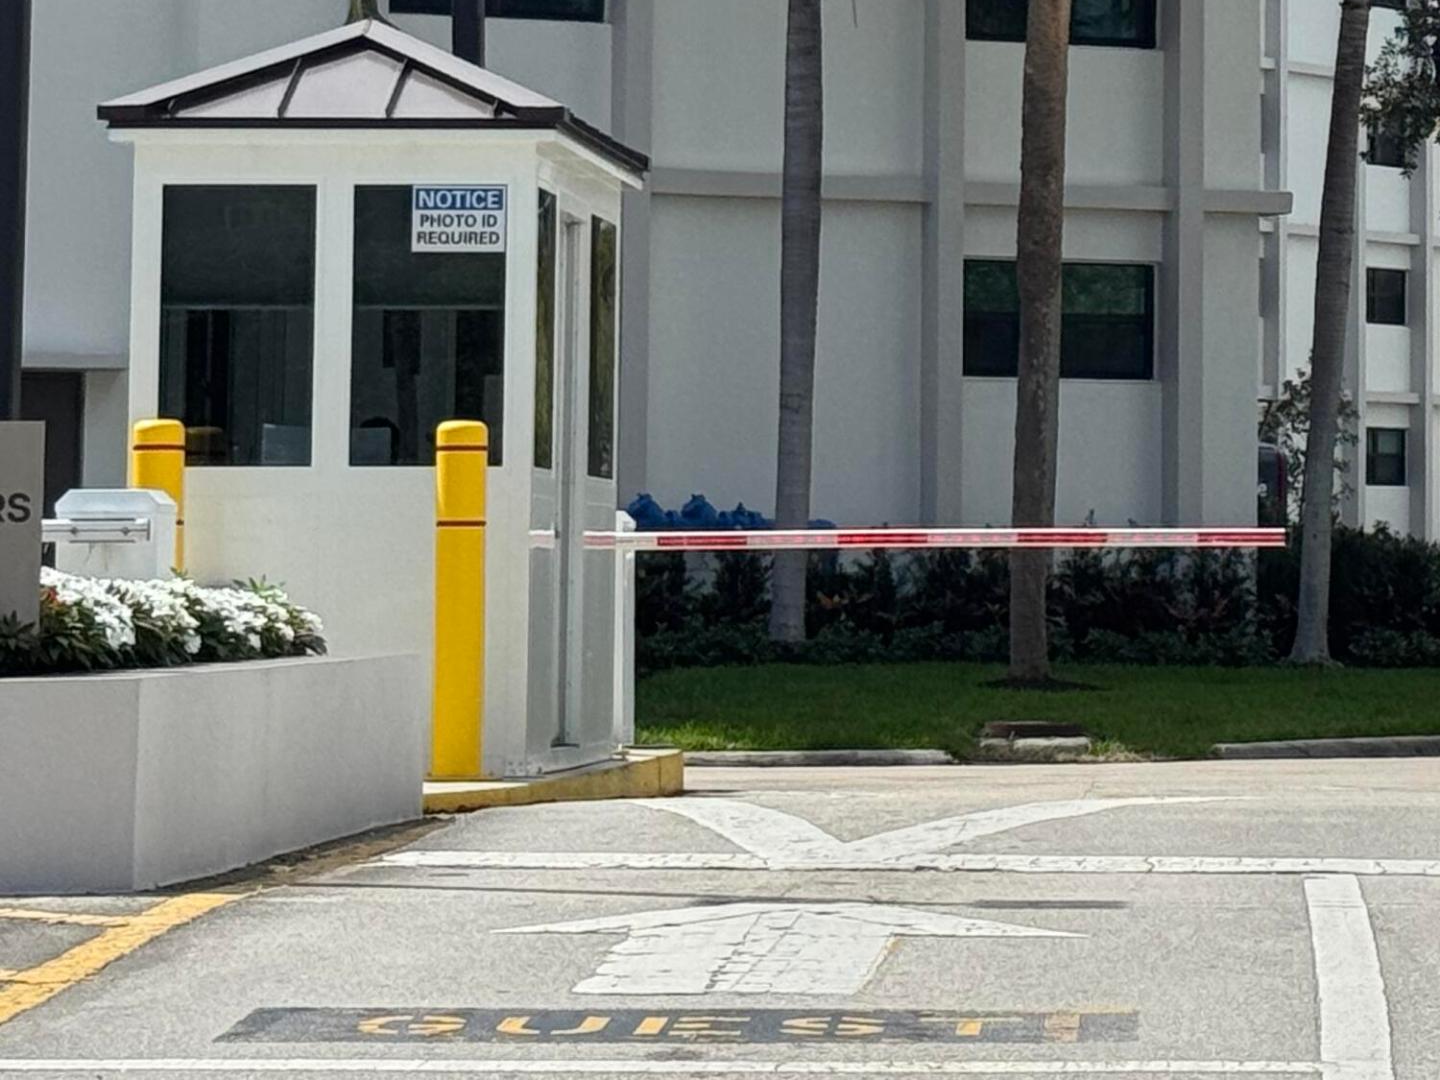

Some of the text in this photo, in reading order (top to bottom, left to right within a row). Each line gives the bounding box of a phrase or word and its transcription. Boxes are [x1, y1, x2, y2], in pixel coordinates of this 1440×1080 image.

[419, 190, 500, 208] NOTICE
[420, 214, 498, 228] PHOTO ID
[417, 231, 500, 245] REQUIRED
[0, 492, 31, 523] S
[358, 1014, 1023, 1036] GUEST
